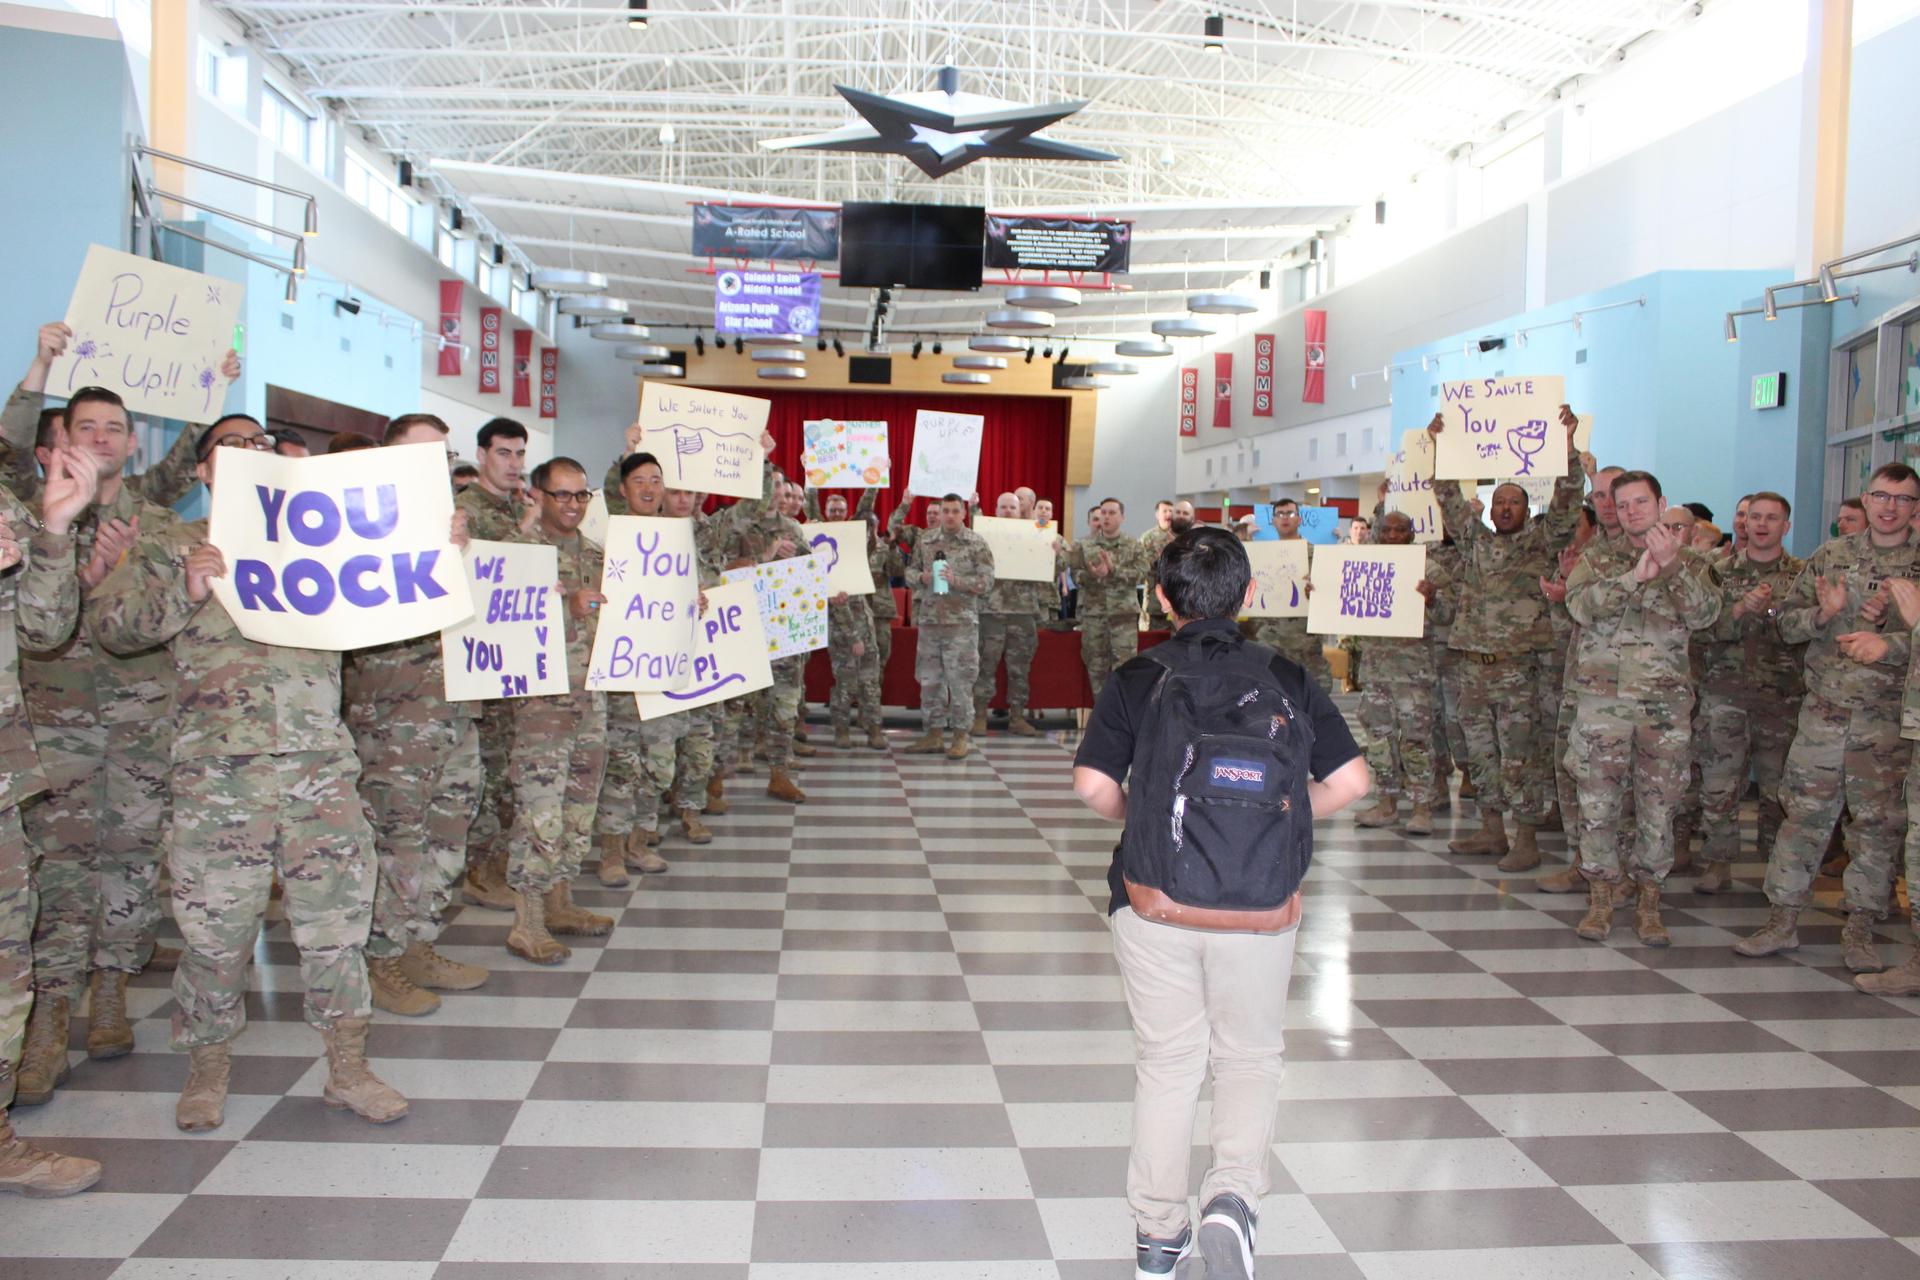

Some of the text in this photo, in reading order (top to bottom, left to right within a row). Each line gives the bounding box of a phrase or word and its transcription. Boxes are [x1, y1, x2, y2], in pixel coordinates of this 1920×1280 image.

[724, 226, 807, 241] A-Rated School
[743, 272, 801, 285] Colonel Smith
[743, 284, 802, 297] Middle School
[105, 272, 190, 341] Purple
[719, 301, 780, 317] Arizona Purple
[725, 315, 743, 328] Star
[743, 316, 774, 329] School
[483, 313, 497, 387] CSMS
[123, 353, 182, 398] Up!!
[543, 352, 555, 413] CSMS
[1257, 339, 1271, 412] CSMS
[1183, 372, 1196, 432] CSMS
[1442, 381, 1476, 402] WE
[1755, 376, 1777, 407] EXIT
[658, 396, 749, 421] We Salute You
[715, 441, 754, 461] Military
[716, 455, 741, 467] Child
[714, 468, 742, 479] Month
[255, 484, 399, 547] YOU
[635, 530, 691, 577] You
[234, 550, 449, 616] ROCK
[474, 556, 506, 584] WE
[1341, 560, 1396, 579] PURPLE
[1343, 571, 1393, 593] UP FOR
[624, 593, 675, 621] Are
[1340, 583, 1395, 609] MILITARY
[1340, 597, 1393, 618] KIDS
[704, 604, 742, 643] ple
[462, 635, 504, 673] YOU
[608, 635, 689, 679] Brave
[693, 653, 720, 682] p!
[501, 674, 528, 698] IN
